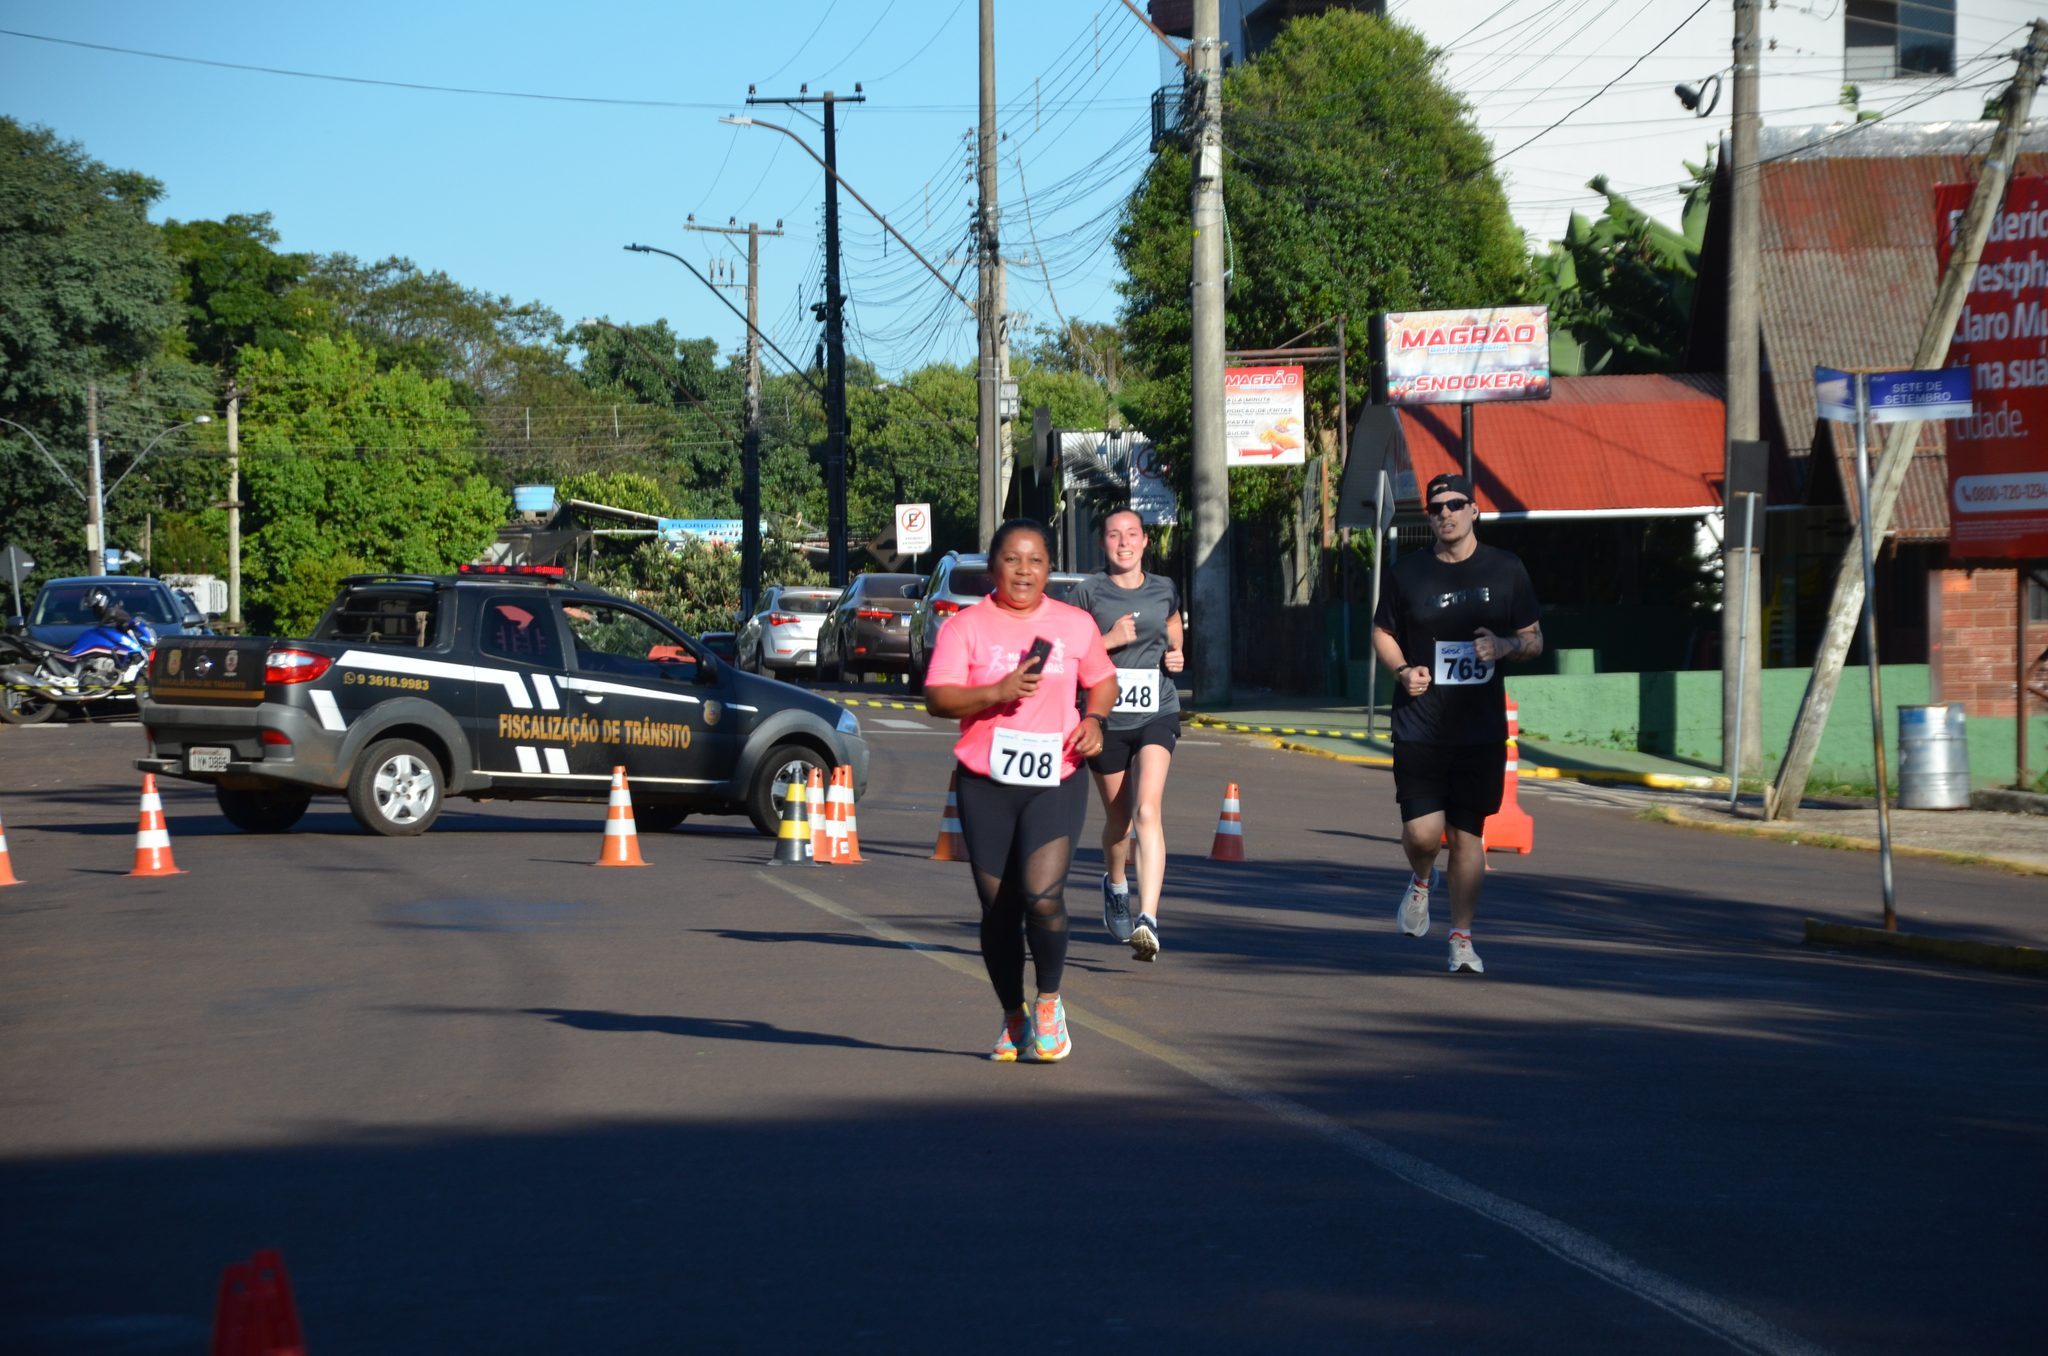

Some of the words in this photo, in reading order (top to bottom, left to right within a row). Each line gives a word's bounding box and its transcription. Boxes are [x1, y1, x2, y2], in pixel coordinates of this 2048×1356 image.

[1401, 318, 1538, 349] MAGRÃO
[1225, 370, 1298, 386] MAGRÃO
[1415, 372, 1526, 392] SNOOKER
[1976, 361, 2004, 390] na
[1884, 391, 1952, 405] SETEMBRO
[1892, 382, 1924, 394] SETE
[1926, 381, 1943, 391] DE
[1444, 657, 1488, 681] 765
[357, 674, 366, 684] 9
[368, 674, 430, 691] 3618.9983
[498, 712, 600, 747] FISCALIZAÇÃO
[602, 719, 621, 744] DE
[624, 716, 692, 750] TRÂNSITO
[1002, 748, 1053, 779] 708
